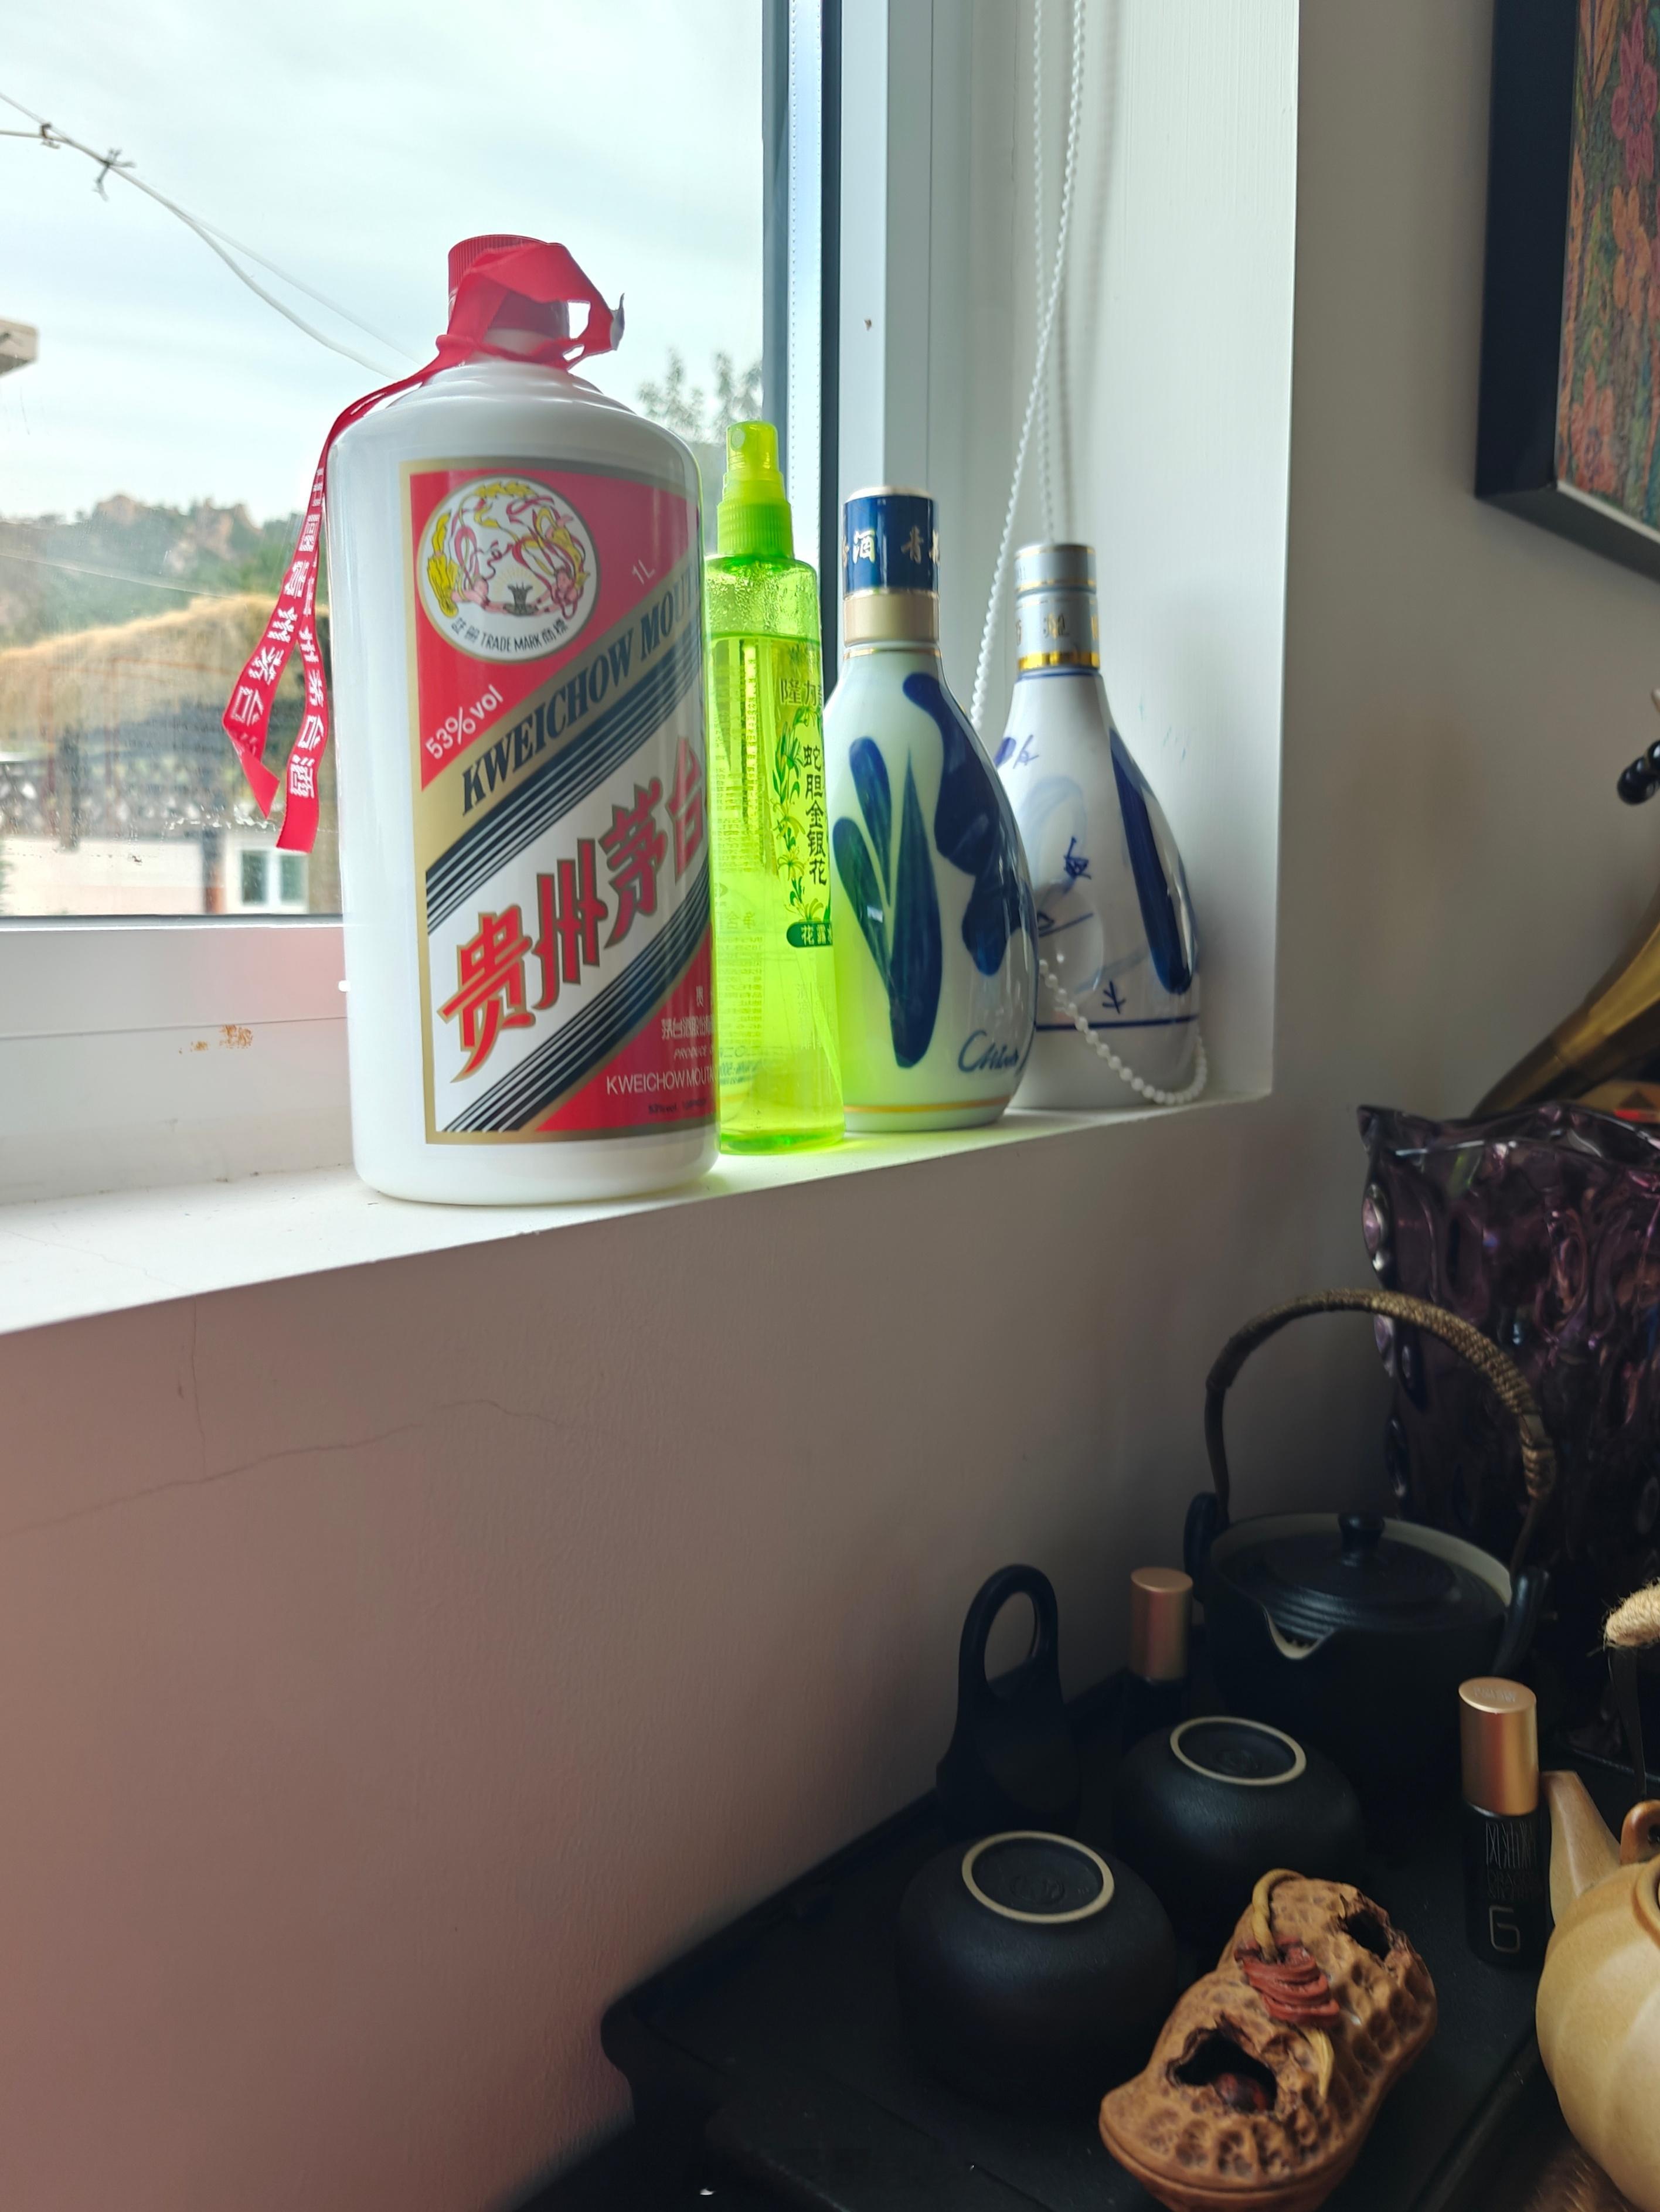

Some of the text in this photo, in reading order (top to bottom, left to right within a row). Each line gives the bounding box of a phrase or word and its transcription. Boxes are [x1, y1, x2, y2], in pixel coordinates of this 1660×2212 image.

[231, 467, 324, 755] 中國貴州茅台
[482, 632, 511, 652] TRADE
[514, 634, 541, 652] MARK
[632, 559, 655, 584] 1L
[462, 627, 635, 817] KWEICHOW
[803, 744, 828, 886] 蛇胆金银花
[437, 736, 703, 1083] 贵州茅台
[607, 1070, 686, 1095] KWEICHOW
